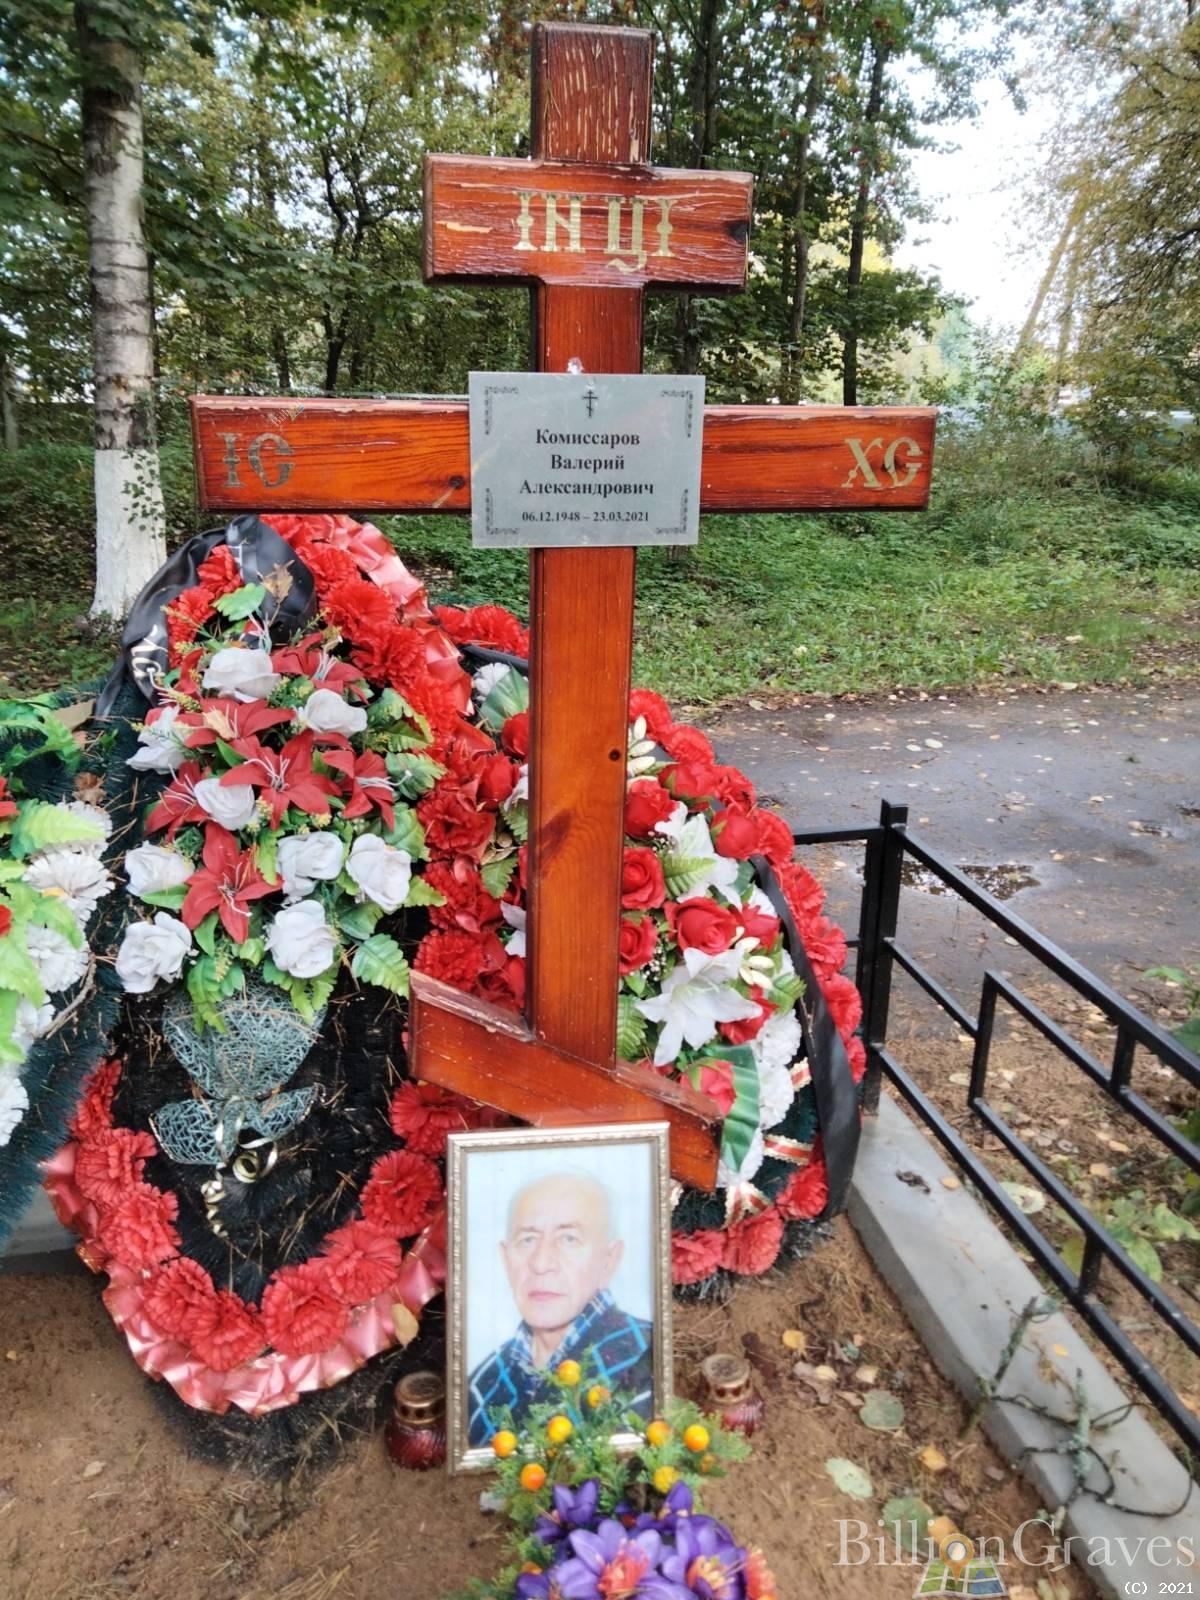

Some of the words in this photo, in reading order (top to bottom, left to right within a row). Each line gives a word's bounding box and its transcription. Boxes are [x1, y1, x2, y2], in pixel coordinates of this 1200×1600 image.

[536, 429, 640, 448] Комиссаров
[551, 454, 625, 473] Валерий
[520, 480, 654, 498] Александрович
[522, 511, 580, 522] 06.12.1948
[593, 511, 649, 522] 23.03.2021
